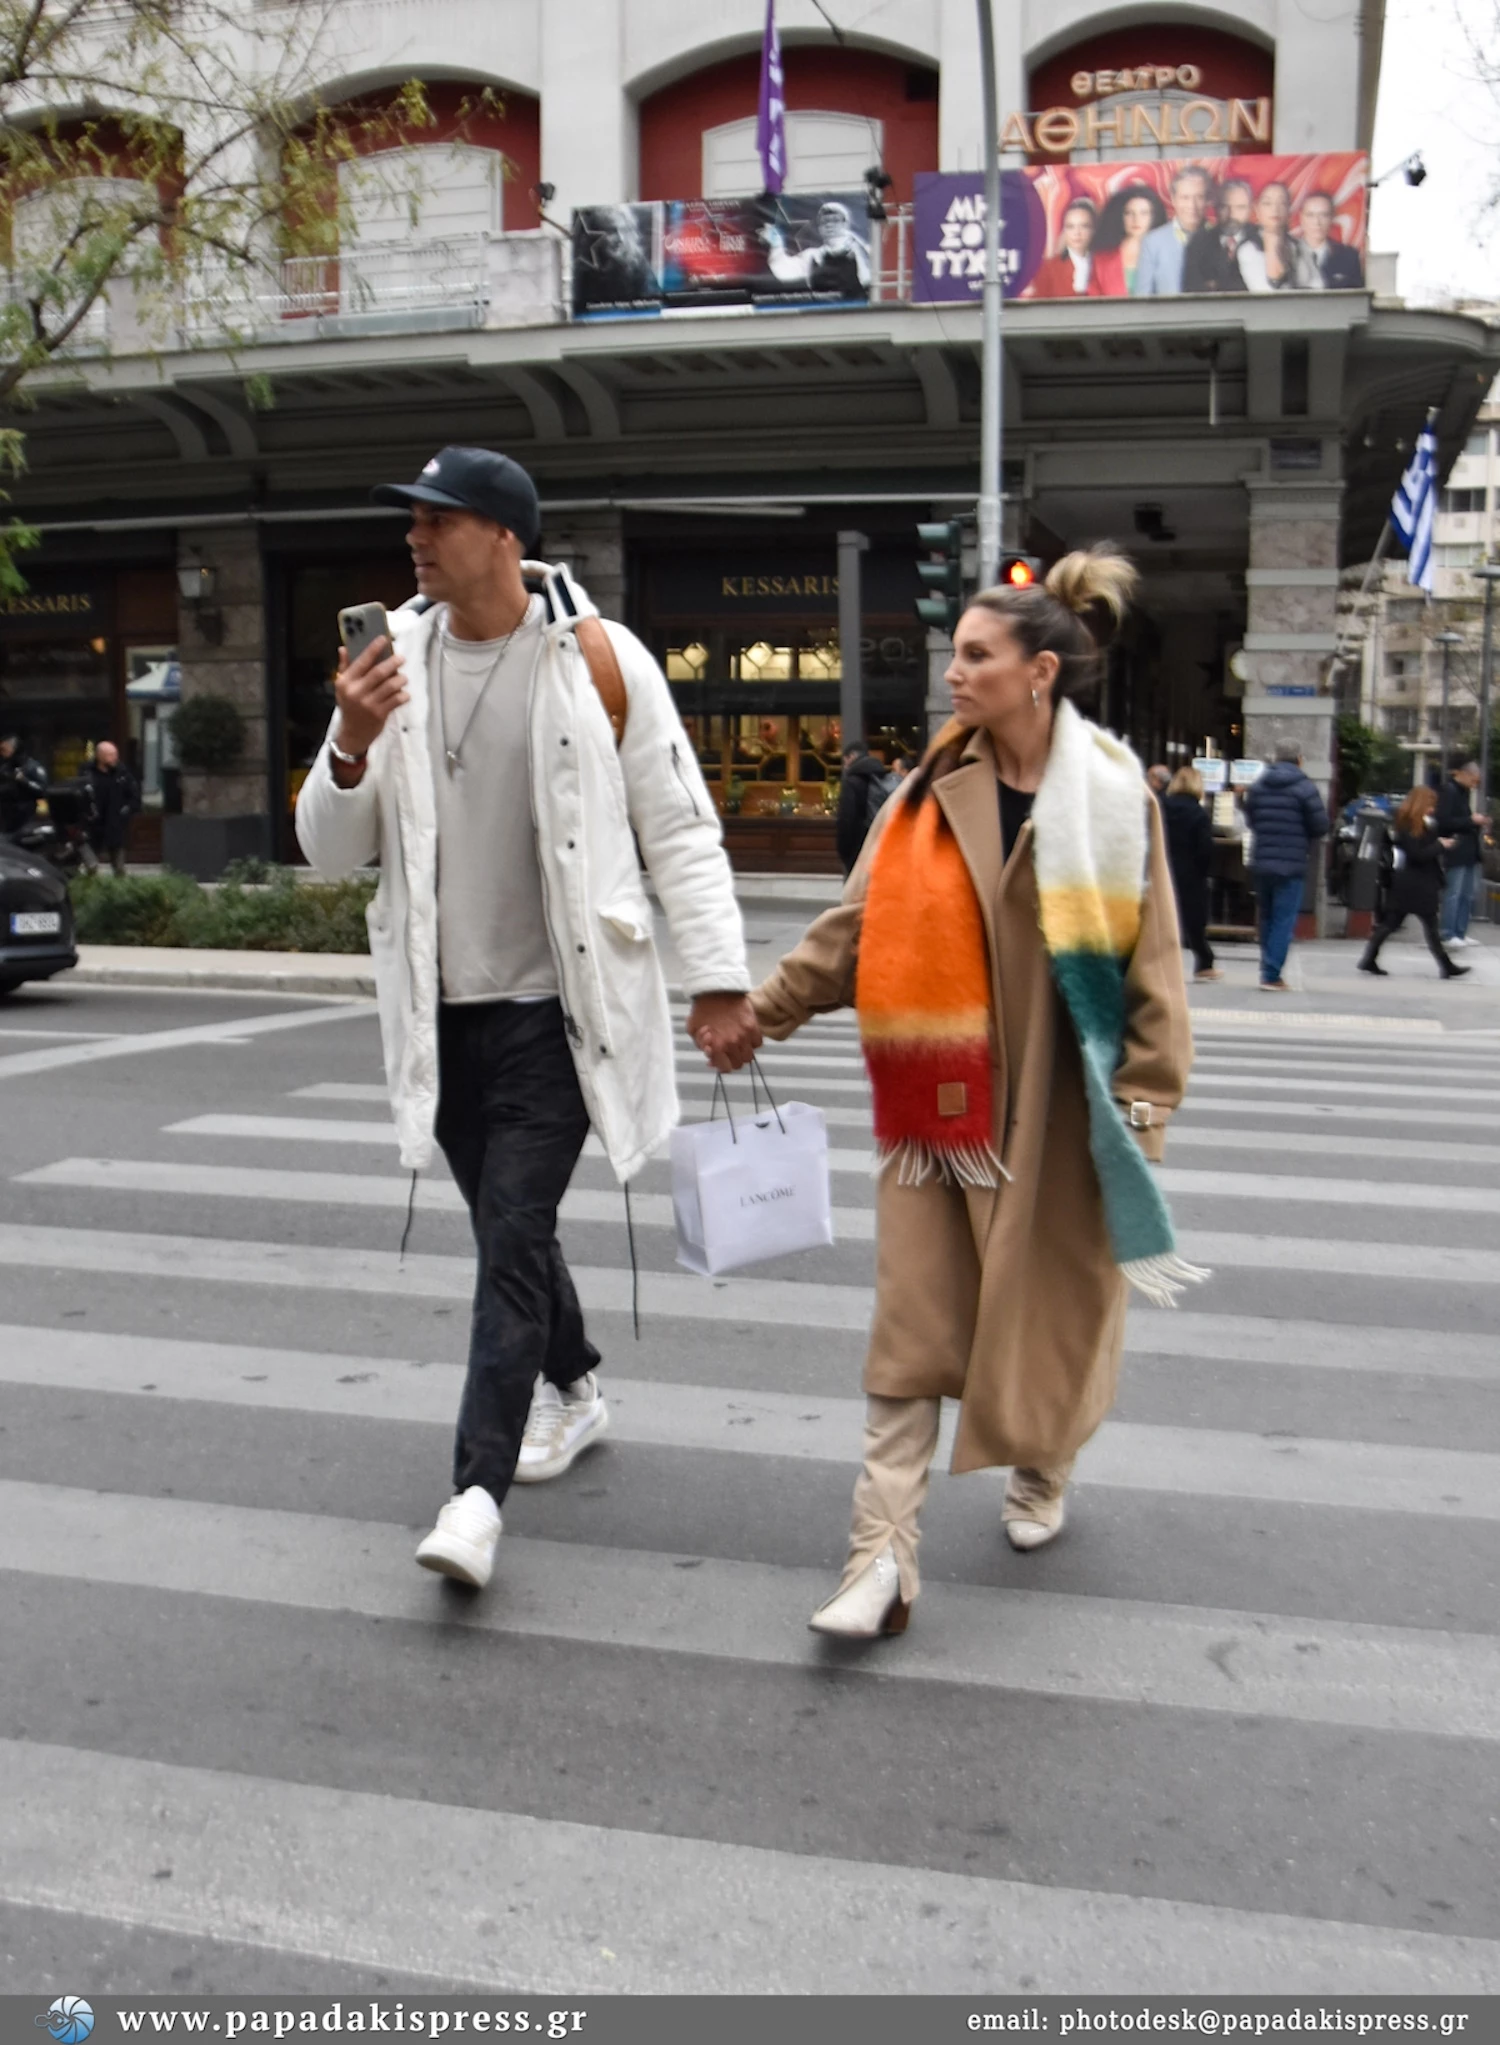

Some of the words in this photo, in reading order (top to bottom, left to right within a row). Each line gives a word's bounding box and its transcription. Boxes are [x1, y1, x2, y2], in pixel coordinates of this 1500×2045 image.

[1070, 63, 1202, 98] ΘΕΑΤΡΟ
[998, 96, 1270, 153] ΑΘΗΝΩΝ
[0, 593, 93, 616] ESSARIS
